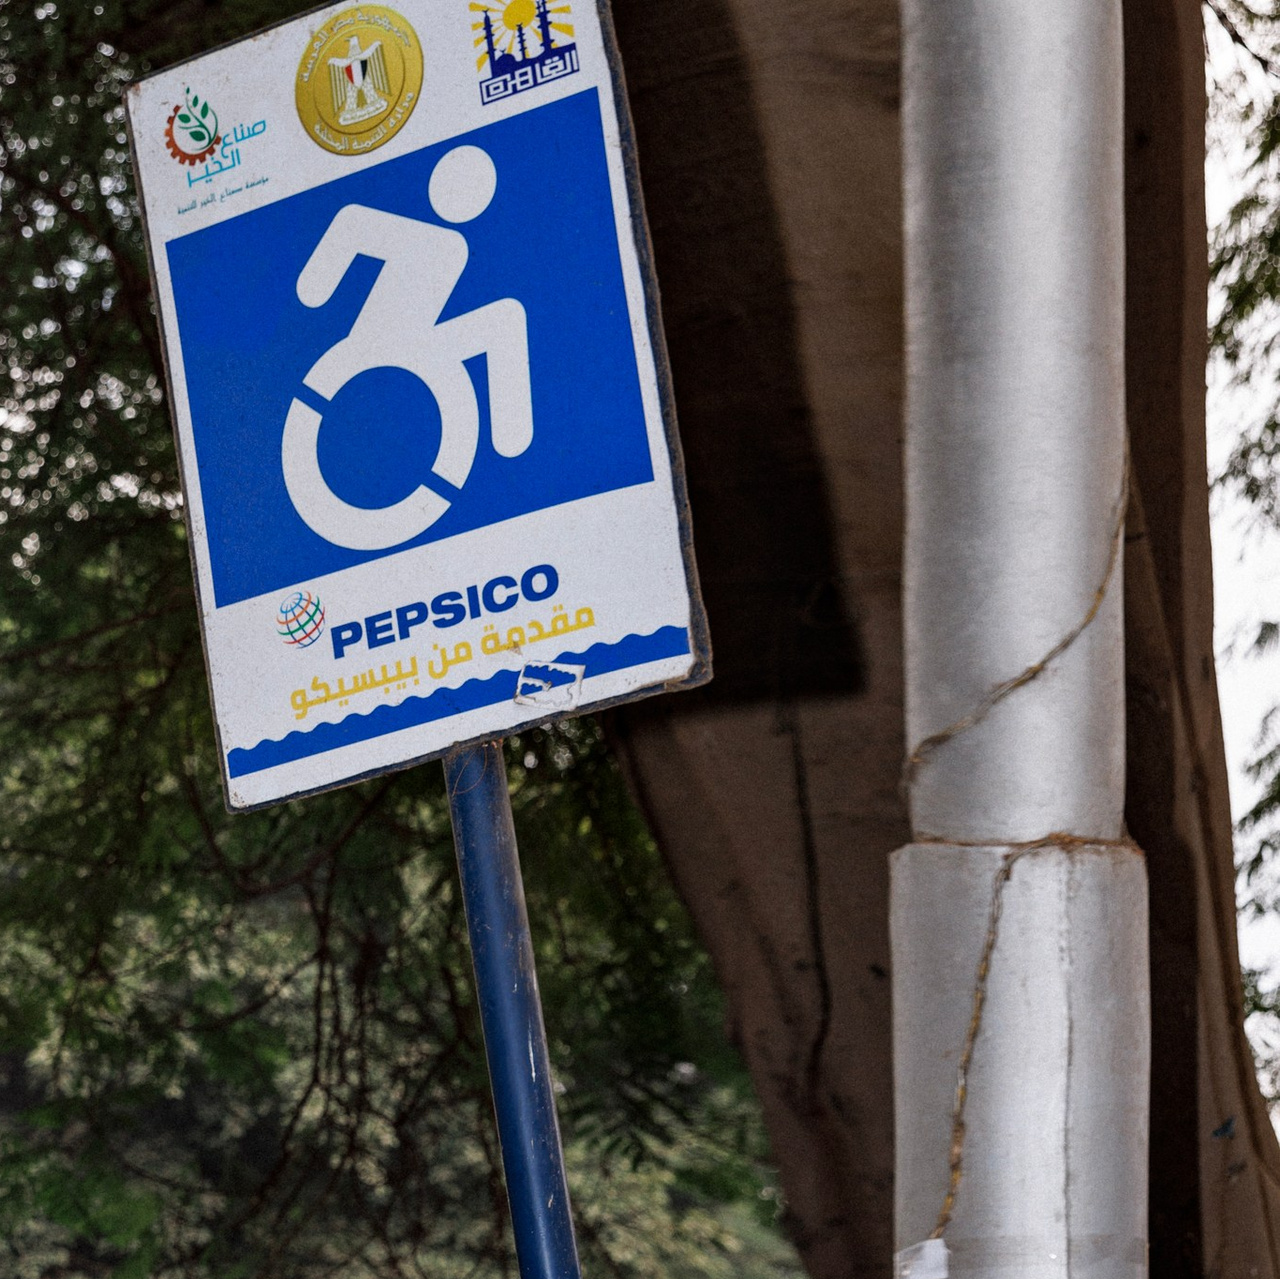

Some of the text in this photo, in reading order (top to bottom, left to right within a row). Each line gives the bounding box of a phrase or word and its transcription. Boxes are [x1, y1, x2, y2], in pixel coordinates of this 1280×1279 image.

[187, 148, 241, 188] الخير
[221, 119, 266, 159] صناع
[330, 563, 559, 660] PEPSICO
[290, 603, 596, 720] مقدمة من بيبسيكو
